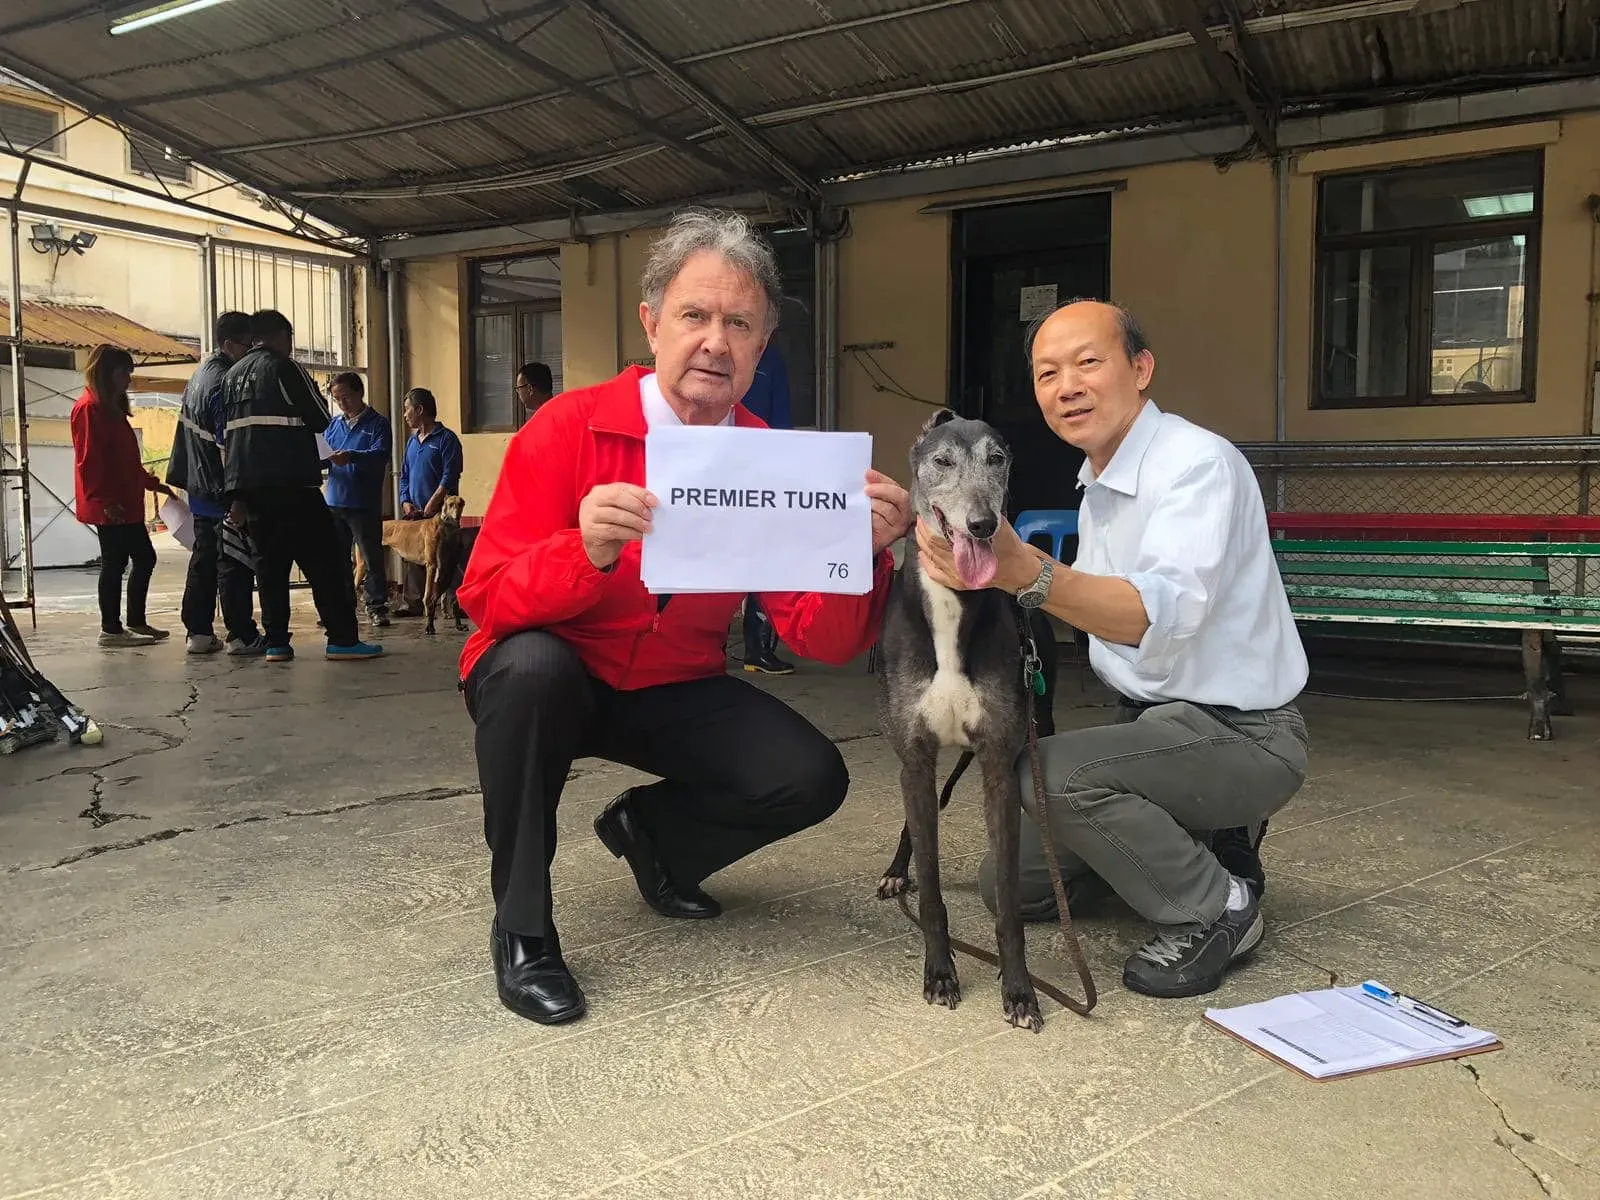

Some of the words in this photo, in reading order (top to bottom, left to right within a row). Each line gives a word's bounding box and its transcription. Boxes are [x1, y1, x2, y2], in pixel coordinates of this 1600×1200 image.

[671, 487, 776, 508] PREMIER
[784, 490, 847, 510] TURN
[827, 562, 849, 579] 76
